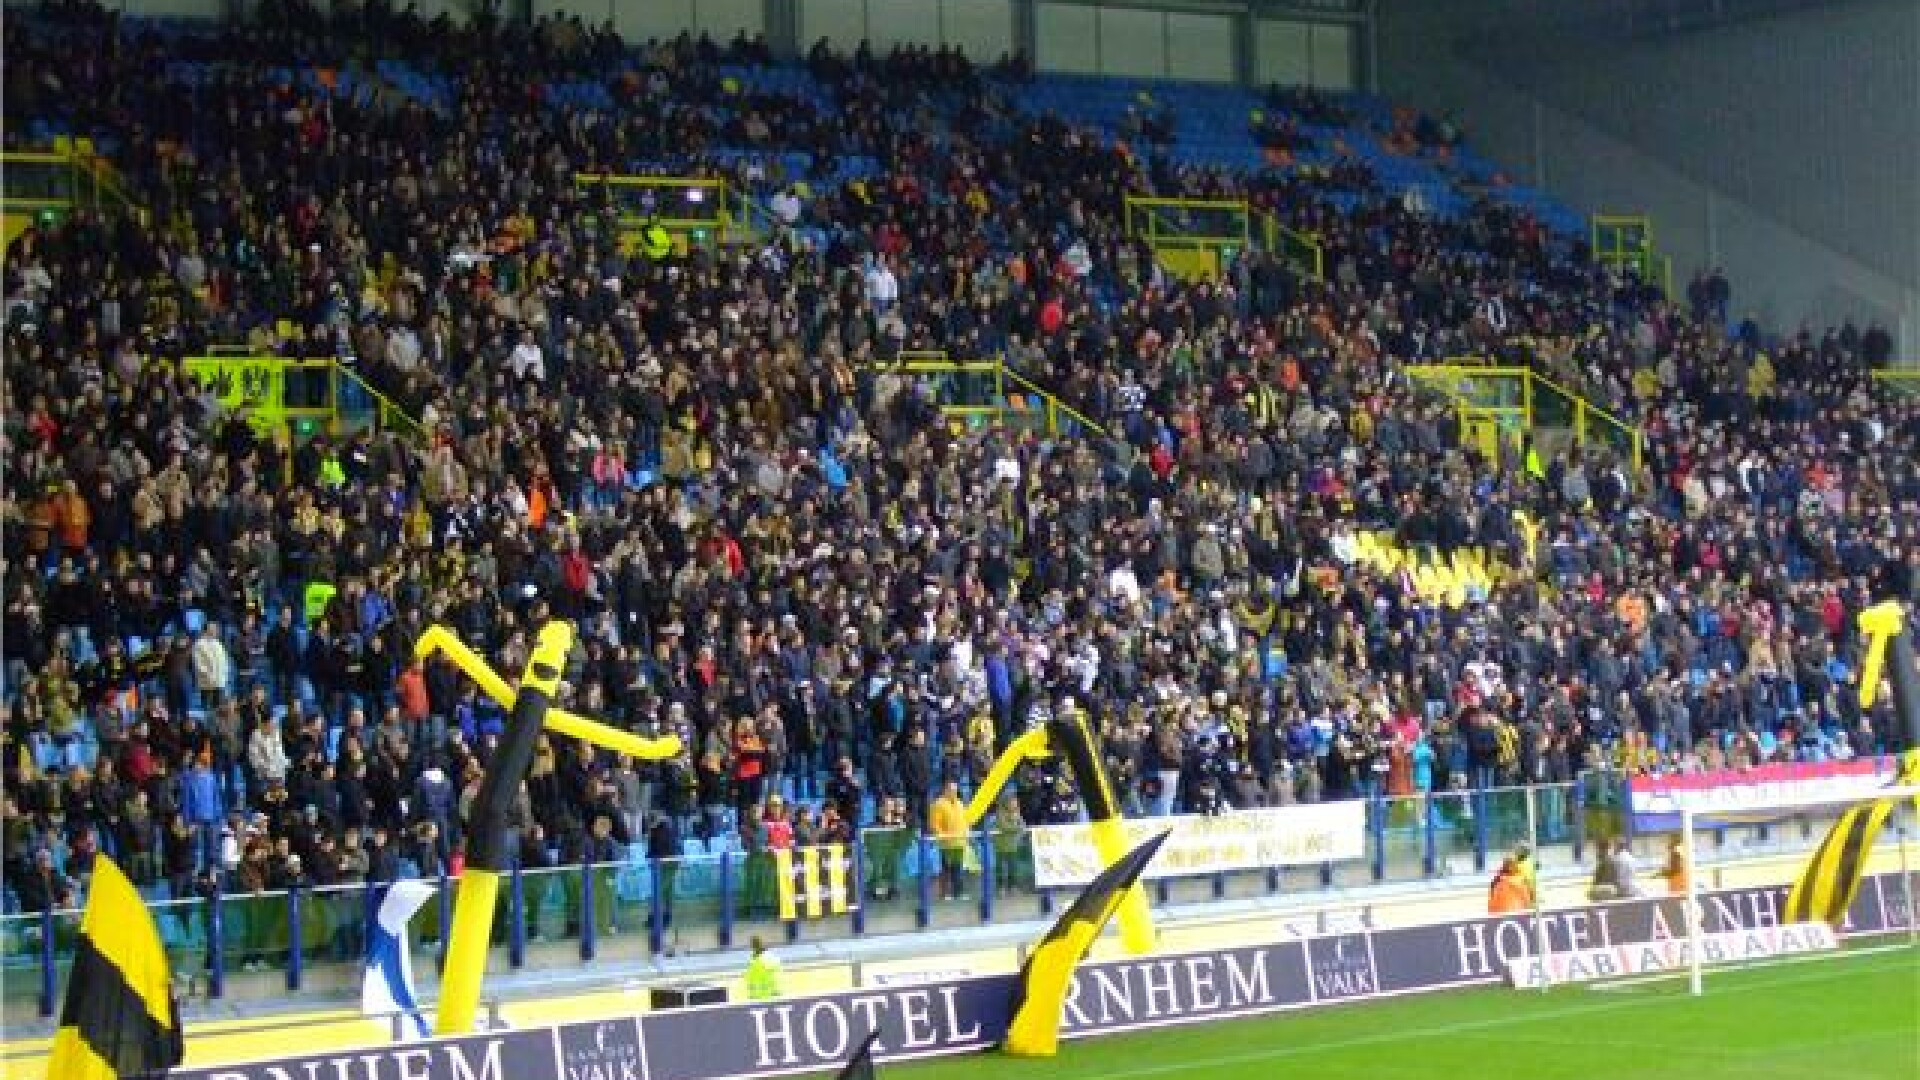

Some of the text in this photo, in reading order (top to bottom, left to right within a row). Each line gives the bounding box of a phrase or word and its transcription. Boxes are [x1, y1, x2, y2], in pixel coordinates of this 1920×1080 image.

[749, 950, 1276, 1066] HOTEL RNHEM
[1316, 967, 1373, 997] VALK
